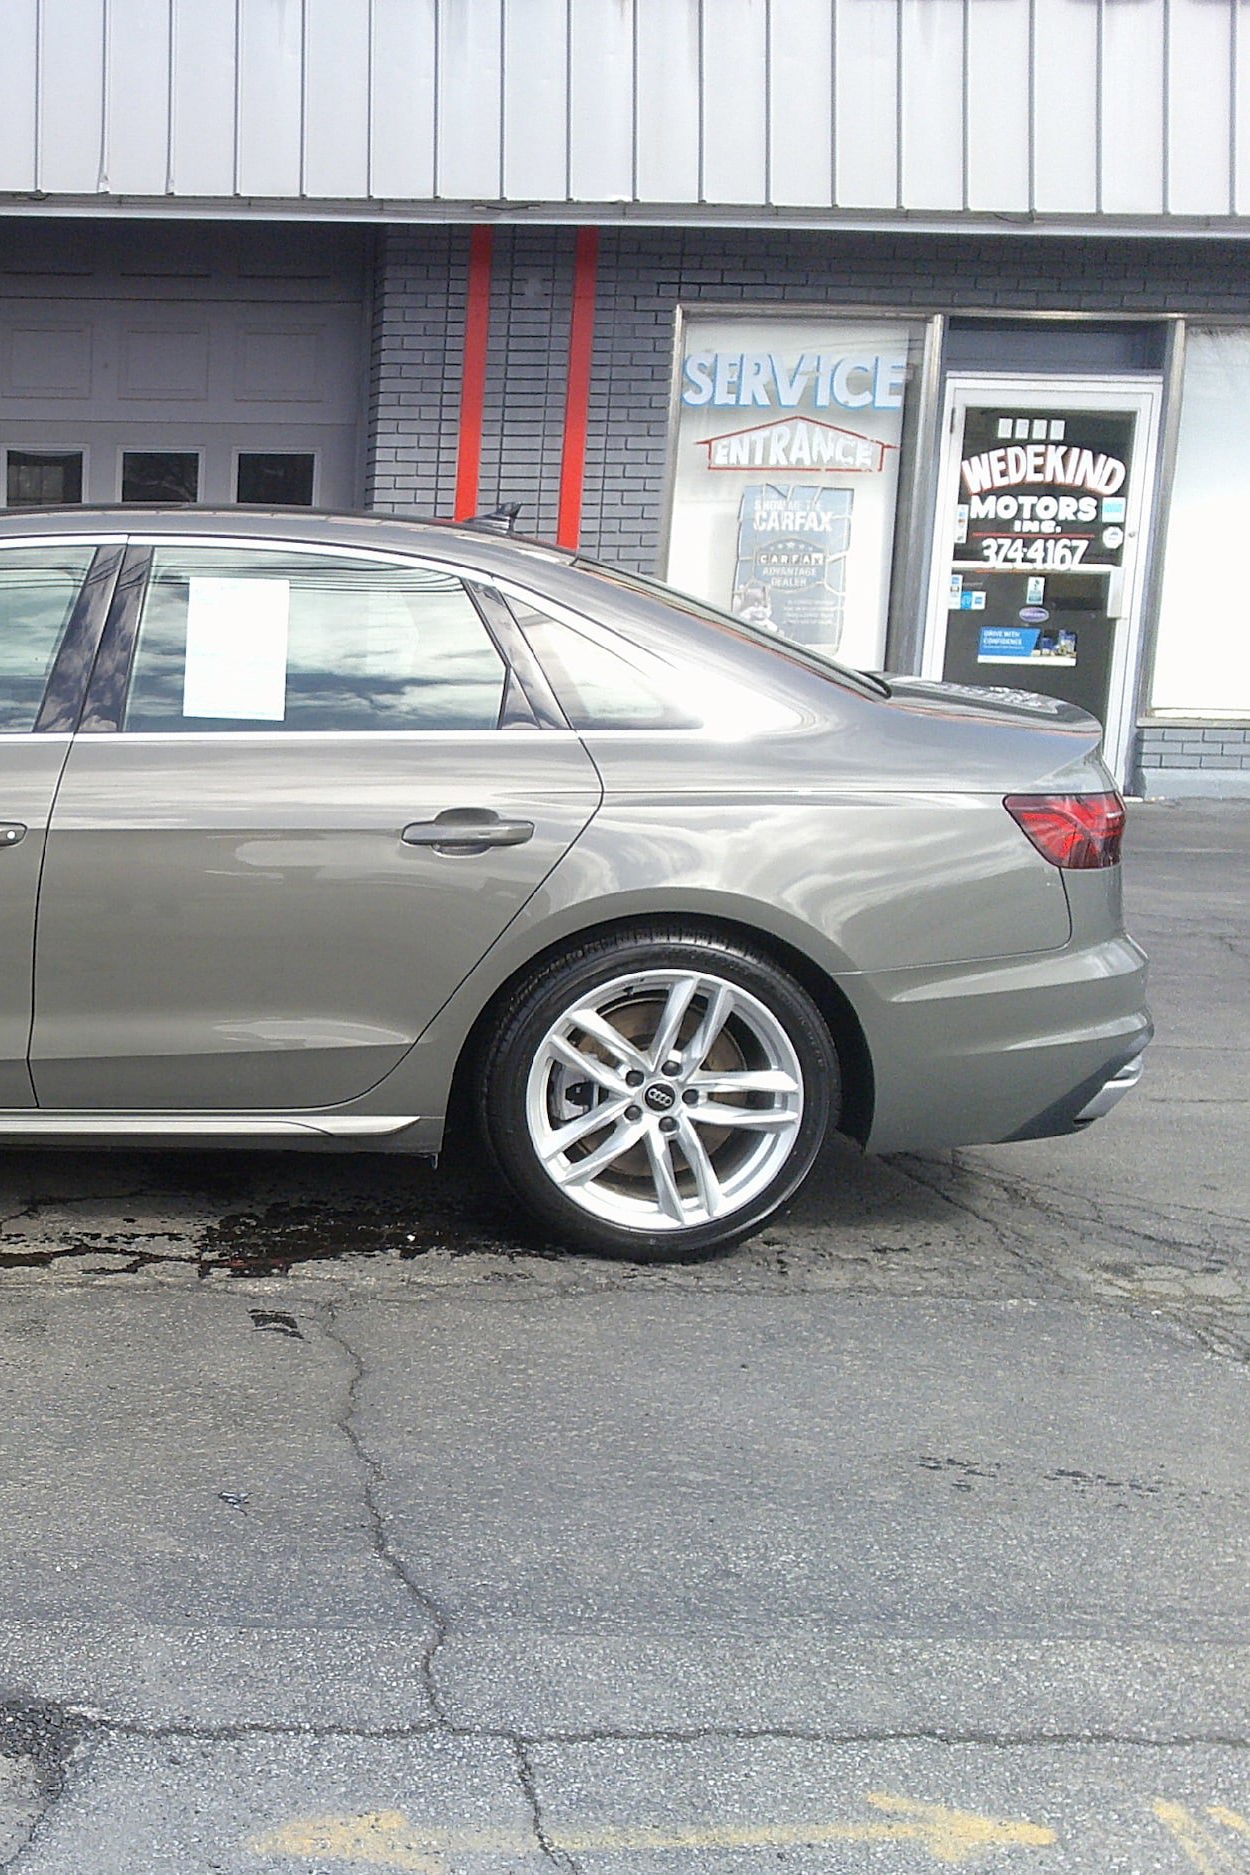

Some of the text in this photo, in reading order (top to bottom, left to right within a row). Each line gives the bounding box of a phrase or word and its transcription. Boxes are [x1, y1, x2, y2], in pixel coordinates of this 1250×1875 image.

[681, 353, 907, 410] SERVICE
[714, 423, 873, 467] ENTRANCE
[961, 444, 1127, 496] WEDEKIND
[970, 495, 1098, 522] MOTORS
[753, 511, 833, 532] CARFAX
[1013, 520, 1062, 534] INC.
[760, 553, 823, 565] CARFAX
[981, 538, 1090, 570] 374-4167
[762, 566, 818, 577] ADVANTAGE
[771, 576, 808, 587] DEALER
